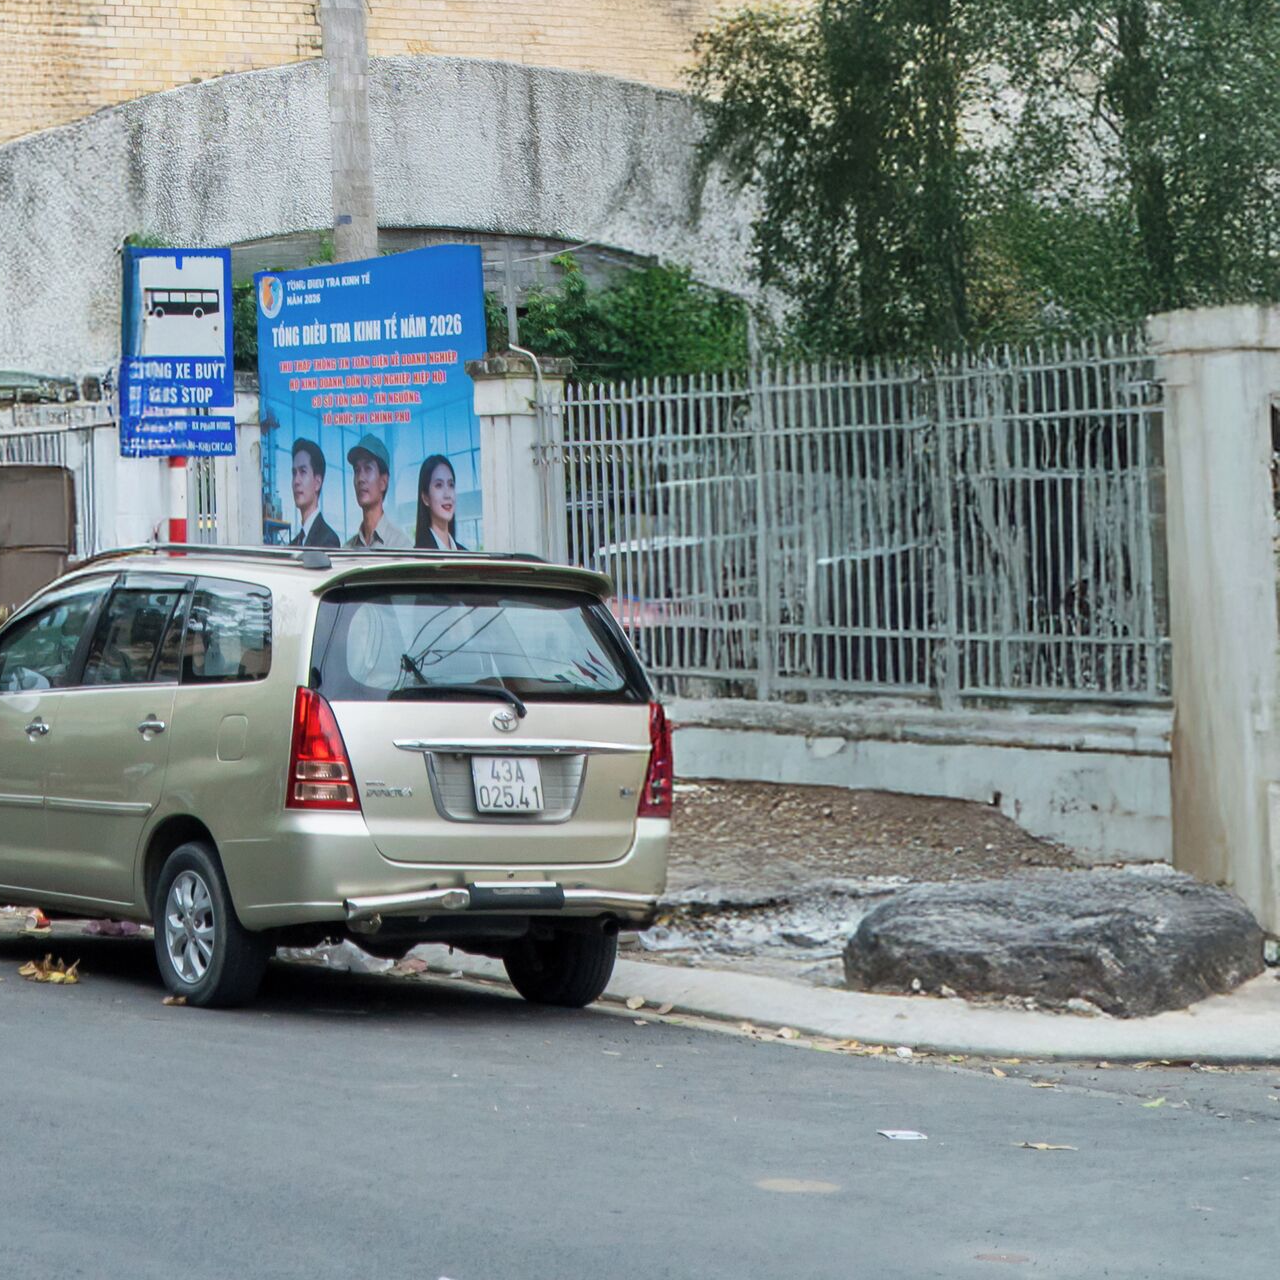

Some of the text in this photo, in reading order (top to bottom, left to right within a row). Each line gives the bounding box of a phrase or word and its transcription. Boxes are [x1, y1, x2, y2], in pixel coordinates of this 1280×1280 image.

[272, 312, 462, 347] TỔNG ĐIỀU TRA KINH TẾ NĂM 2026
[176, 363, 191, 379] XE
[181, 387, 213, 403] STOP
[491, 759, 525, 783] 43A
[479, 785, 540, 809] 025.41
